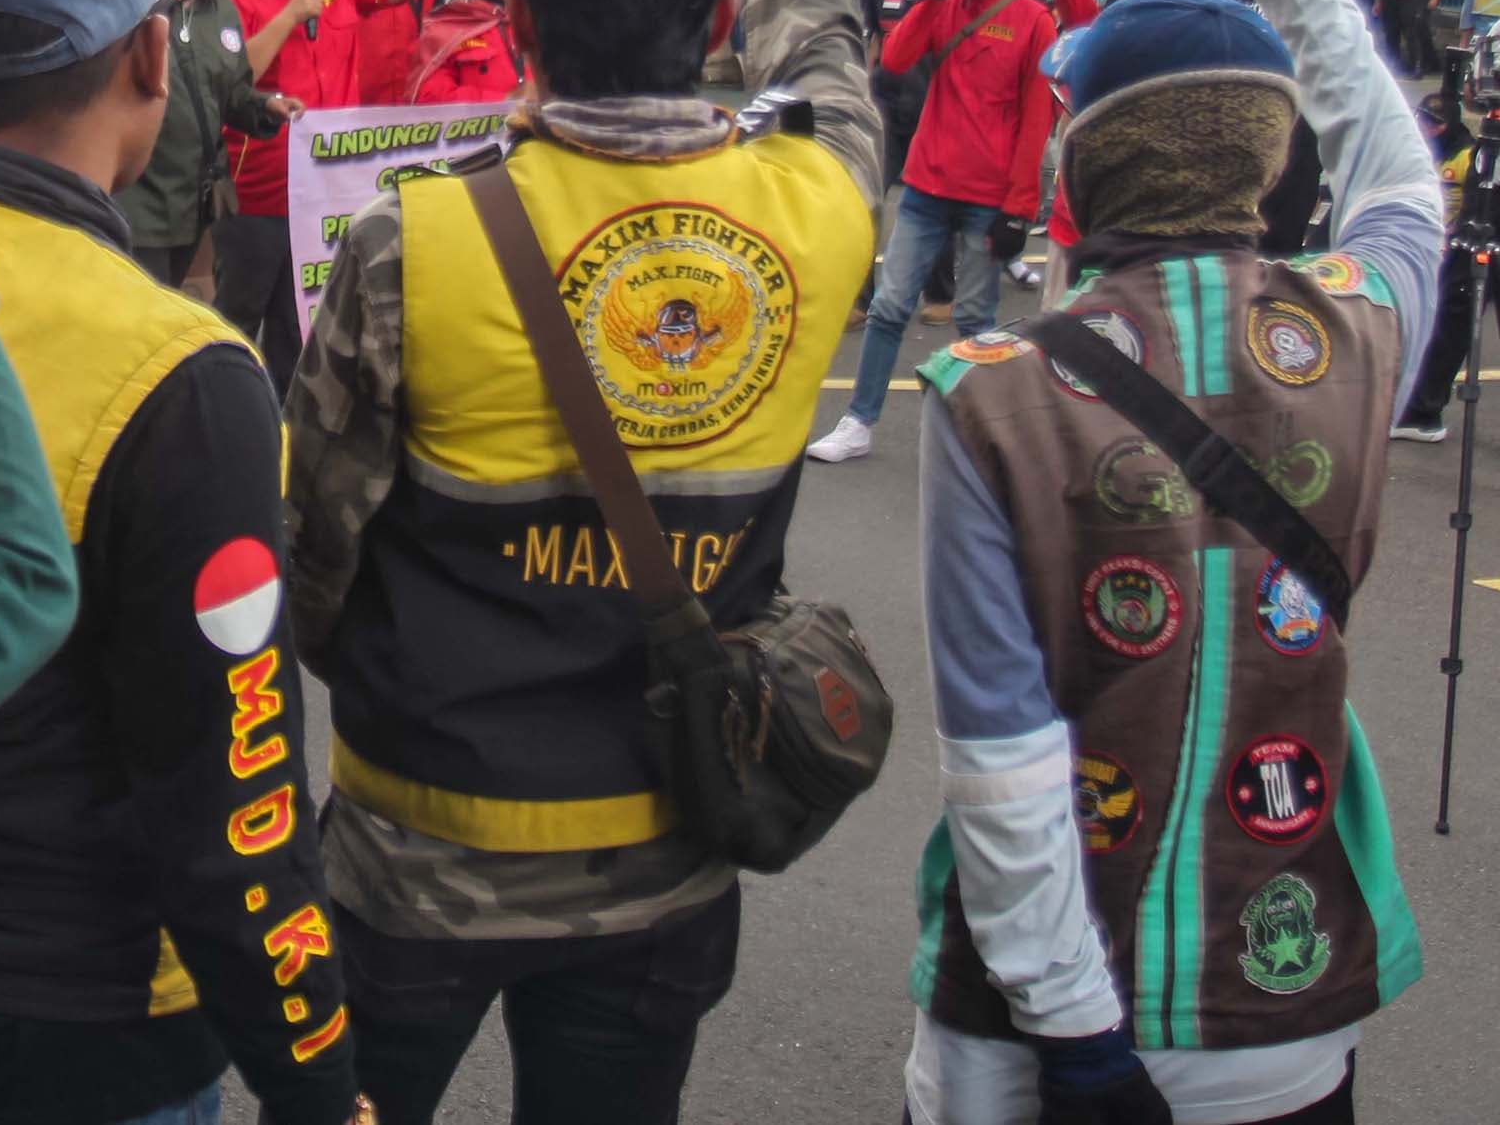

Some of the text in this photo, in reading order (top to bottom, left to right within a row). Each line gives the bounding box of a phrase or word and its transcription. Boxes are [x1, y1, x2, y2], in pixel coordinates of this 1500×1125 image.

[311, 114, 508, 159] LINDUNGI DRIV
[562, 212, 786, 306] MAXIM FIGHTER
[636, 378, 707, 397] maxim
